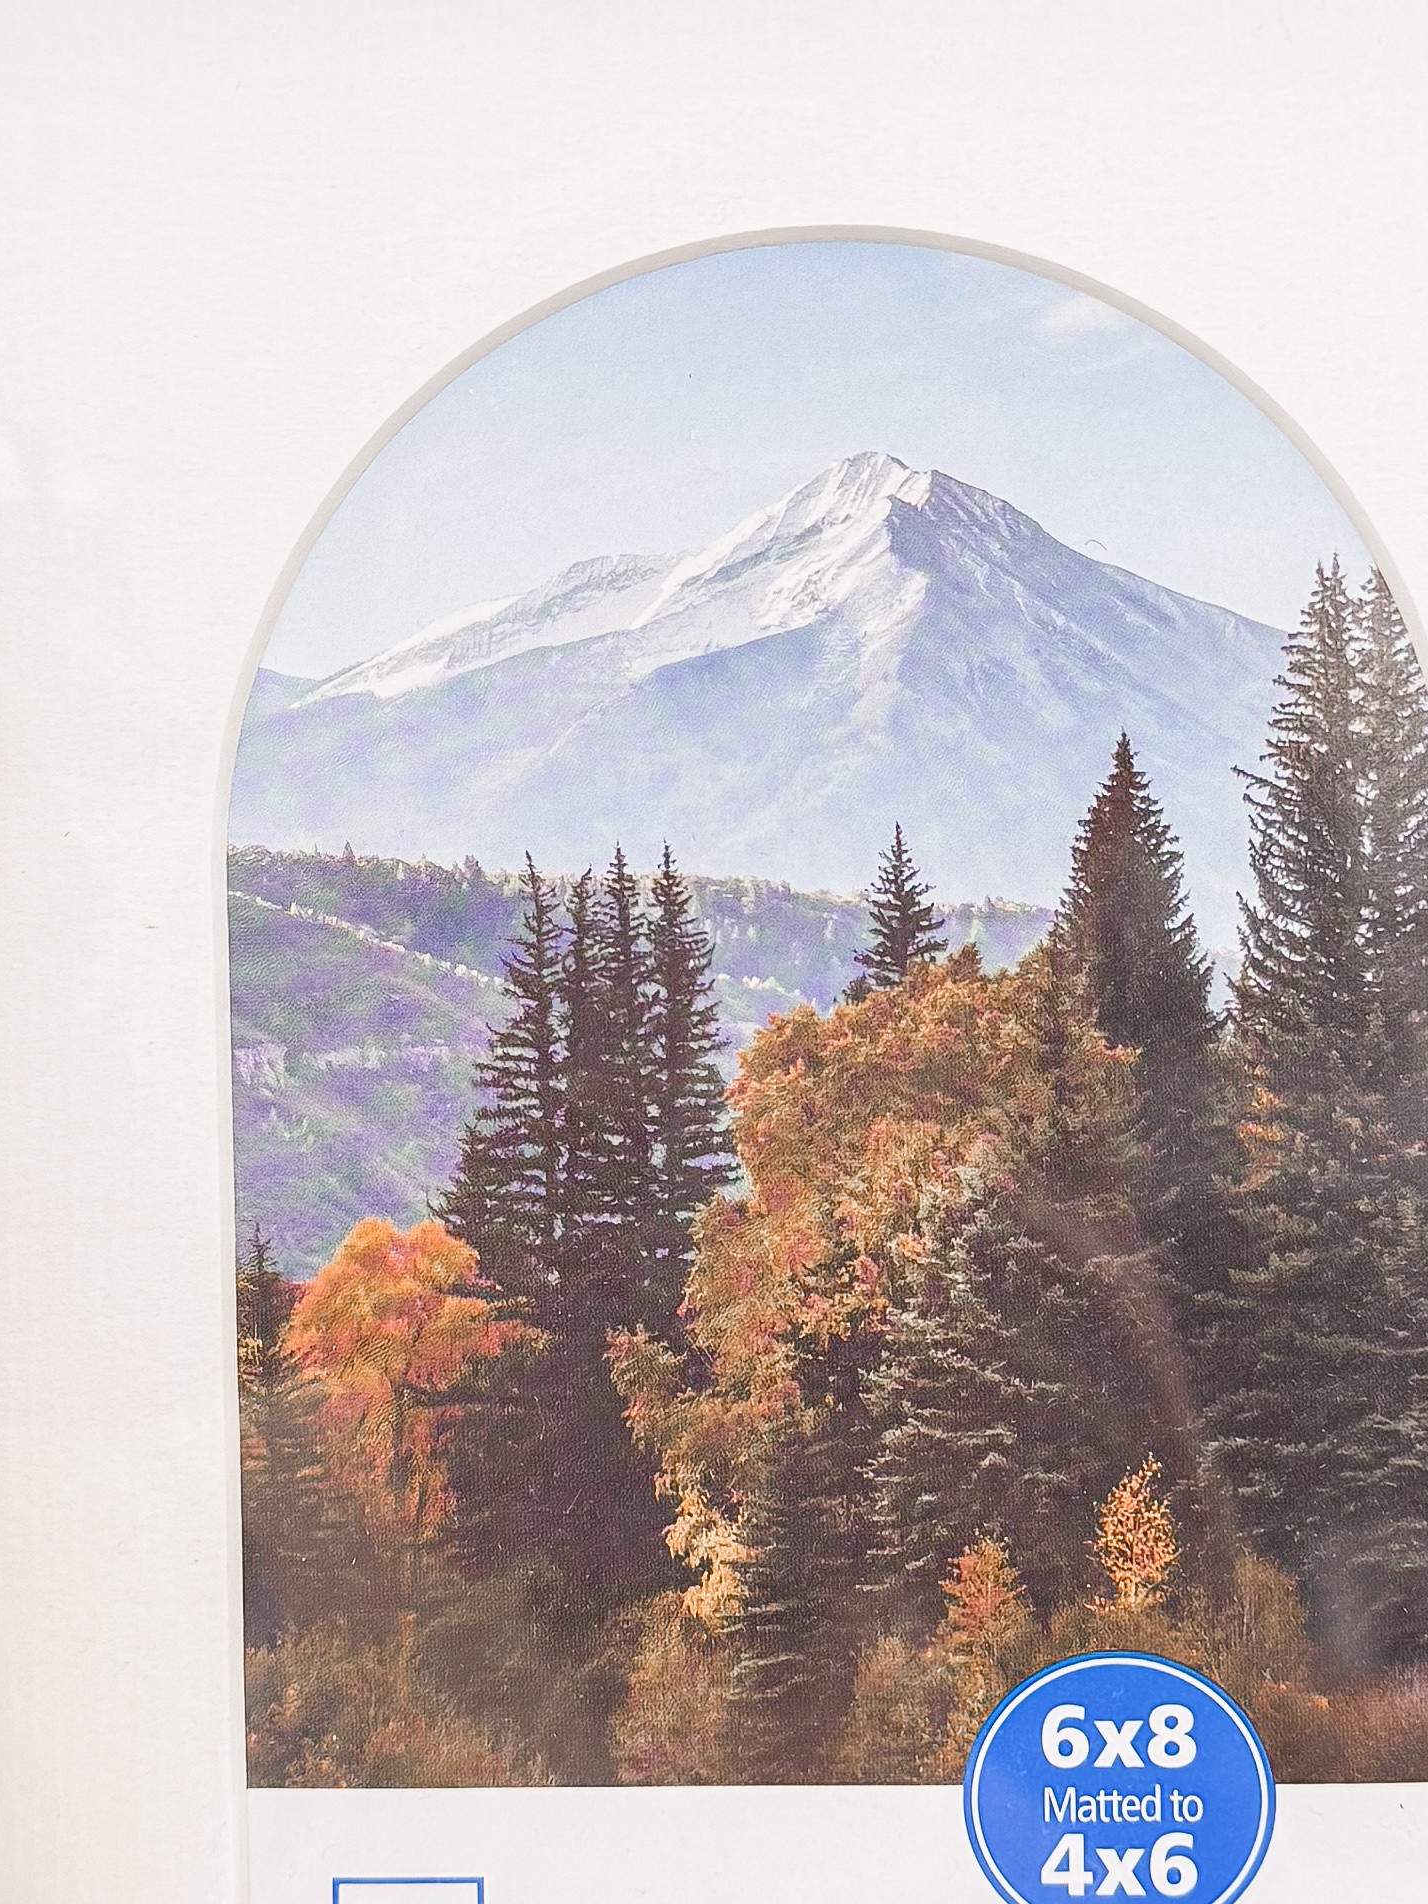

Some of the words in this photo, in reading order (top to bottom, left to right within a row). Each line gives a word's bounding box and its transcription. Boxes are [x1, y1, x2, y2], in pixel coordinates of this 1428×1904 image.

[1040, 1703, 1198, 1769] 6x8
[1042, 1783, 1162, 1824] Matted
[1169, 1788, 1204, 1824] to
[1040, 1831, 1199, 1897] 4x6
